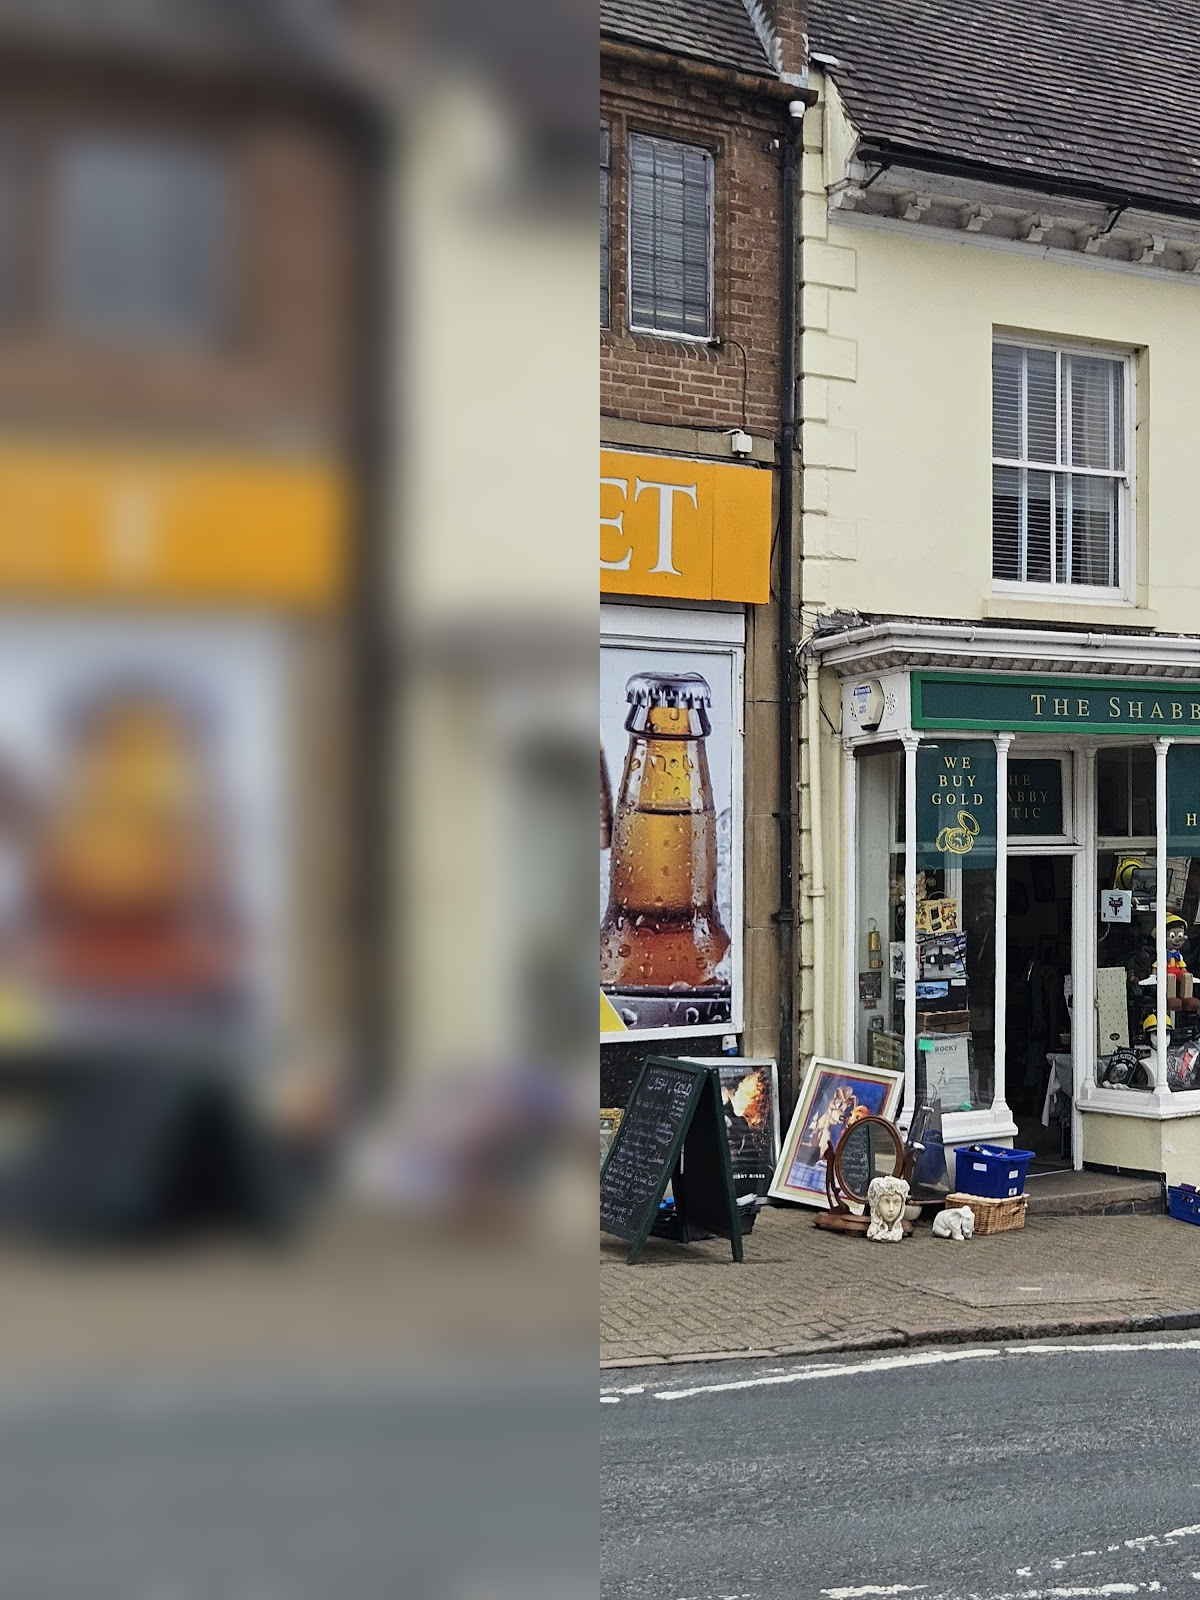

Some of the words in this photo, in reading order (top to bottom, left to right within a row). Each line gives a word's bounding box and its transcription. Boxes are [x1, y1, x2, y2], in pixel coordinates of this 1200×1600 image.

[1031, 694, 1090, 717] THE
[944, 757, 971, 769] WE
[938, 775, 976, 787] BUY
[1008, 775, 1031, 786] HE
[931, 793, 983, 805] GOLD
[1011, 807, 1041, 819] TIC
[935, 1044, 958, 1052] ROCKY
